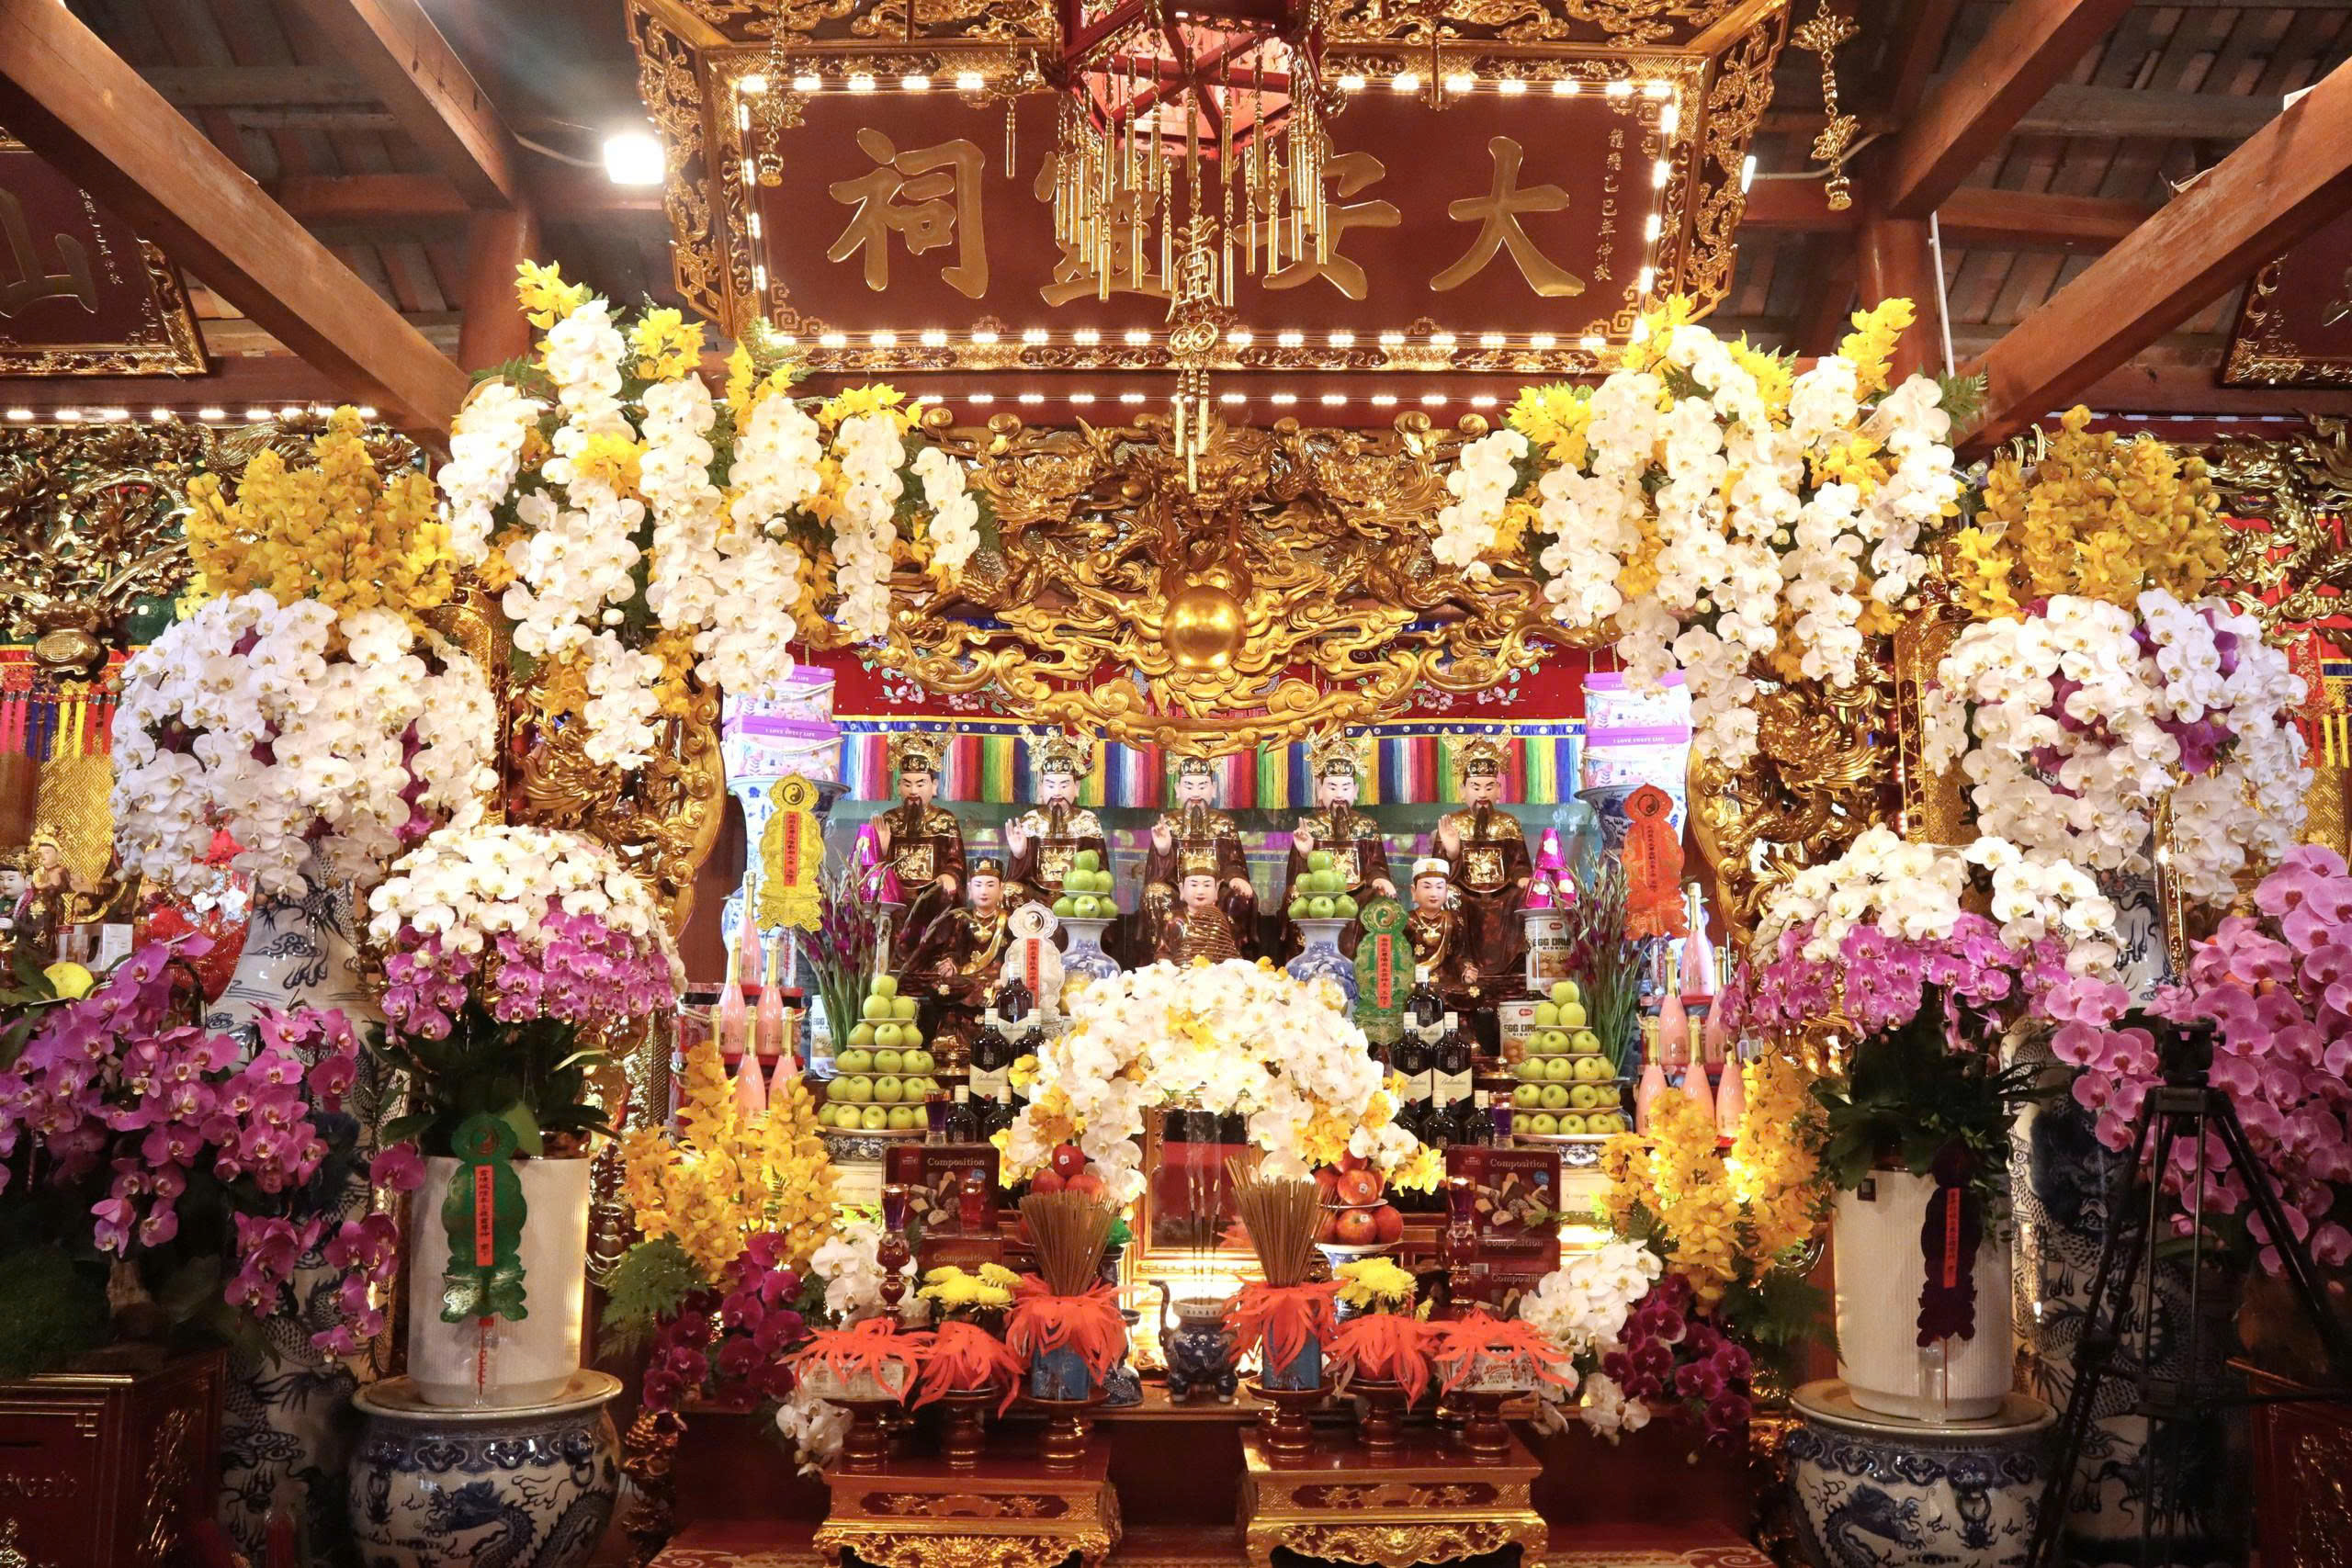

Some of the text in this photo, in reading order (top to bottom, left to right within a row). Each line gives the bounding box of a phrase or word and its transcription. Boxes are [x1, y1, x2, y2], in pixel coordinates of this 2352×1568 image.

[927, 1157, 985, 1168] Composition
[1489, 1158, 1548, 1170] Composition
[933, 1253, 993, 1265] Composition
